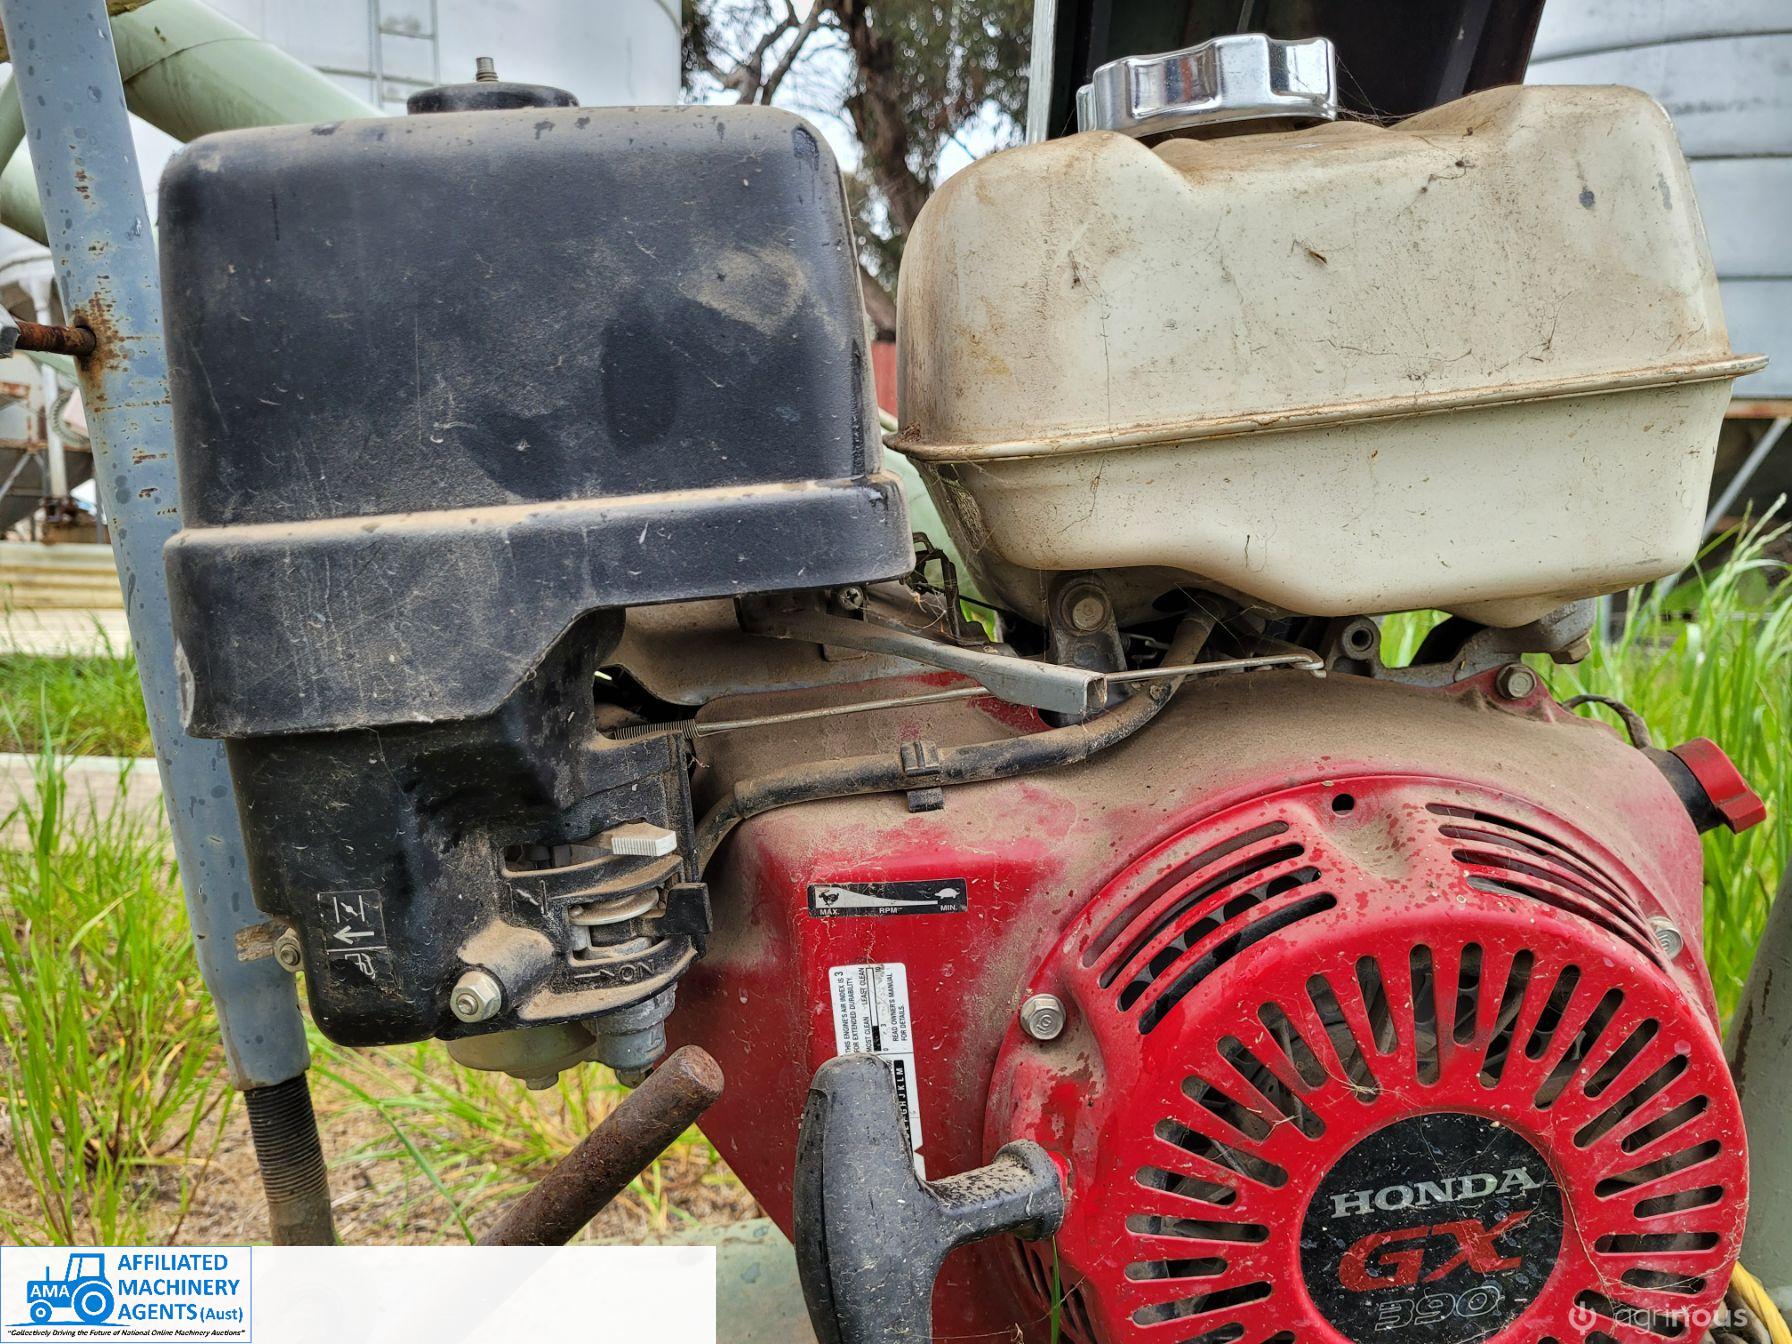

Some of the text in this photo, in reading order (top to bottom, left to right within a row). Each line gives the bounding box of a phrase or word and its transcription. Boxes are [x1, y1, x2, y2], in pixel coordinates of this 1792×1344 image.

[819, 907, 840, 916] MAX.
[879, 907, 898, 915] RPM
[940, 904, 957, 912] MIN.
[620, 959, 655, 981] ON
[838, 985, 846, 1003] INDEX
[858, 967, 868, 1005] LEAST CLEAN
[886, 973, 899, 1041] READ OWNER'S MANUAL
[842, 1014, 850, 1039] ENGINE'S
[850, 1011, 859, 1041] EXTENDED
[863, 1017, 872, 1052] MOST CLEAN
[1330, 1167, 1544, 1219] HONDA
[1338, 1210, 1531, 1293] GX
[1375, 1285, 1501, 1332] 390
